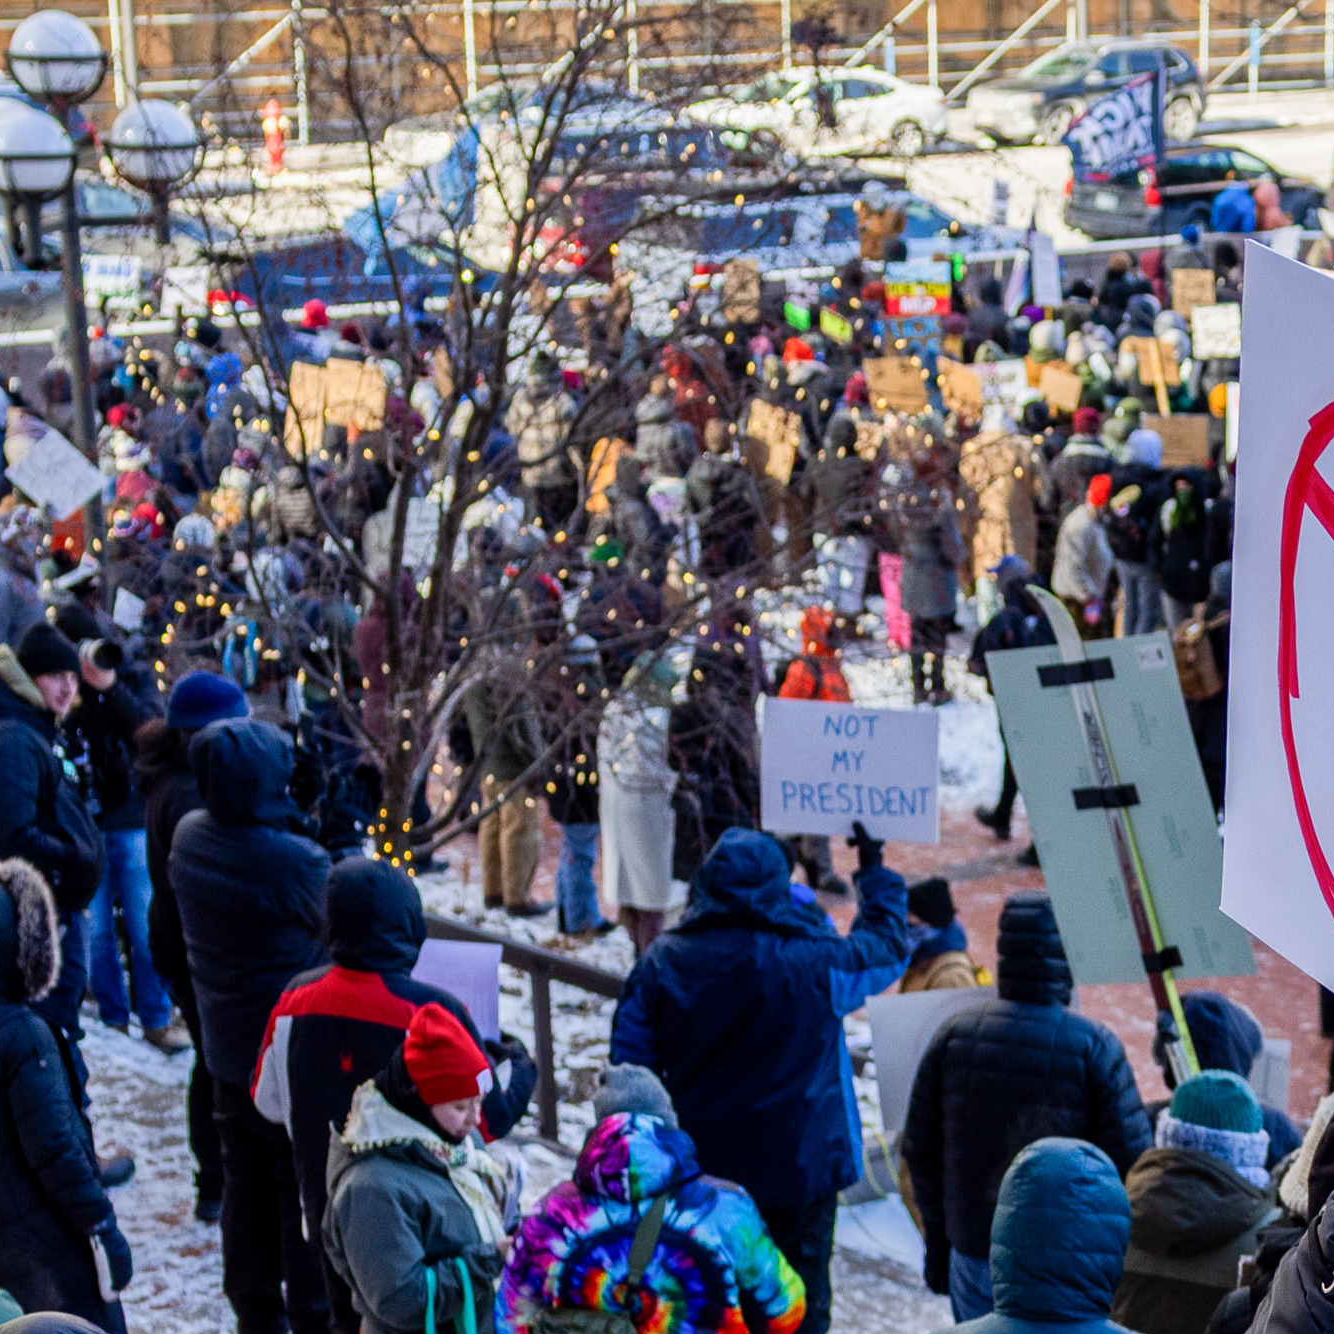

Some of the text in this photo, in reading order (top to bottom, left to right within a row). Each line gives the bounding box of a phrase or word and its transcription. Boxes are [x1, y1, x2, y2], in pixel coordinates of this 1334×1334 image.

[823, 714, 880, 739] NOT
[831, 749, 865, 772] MY
[781, 780, 930, 817] PRESIDENT
